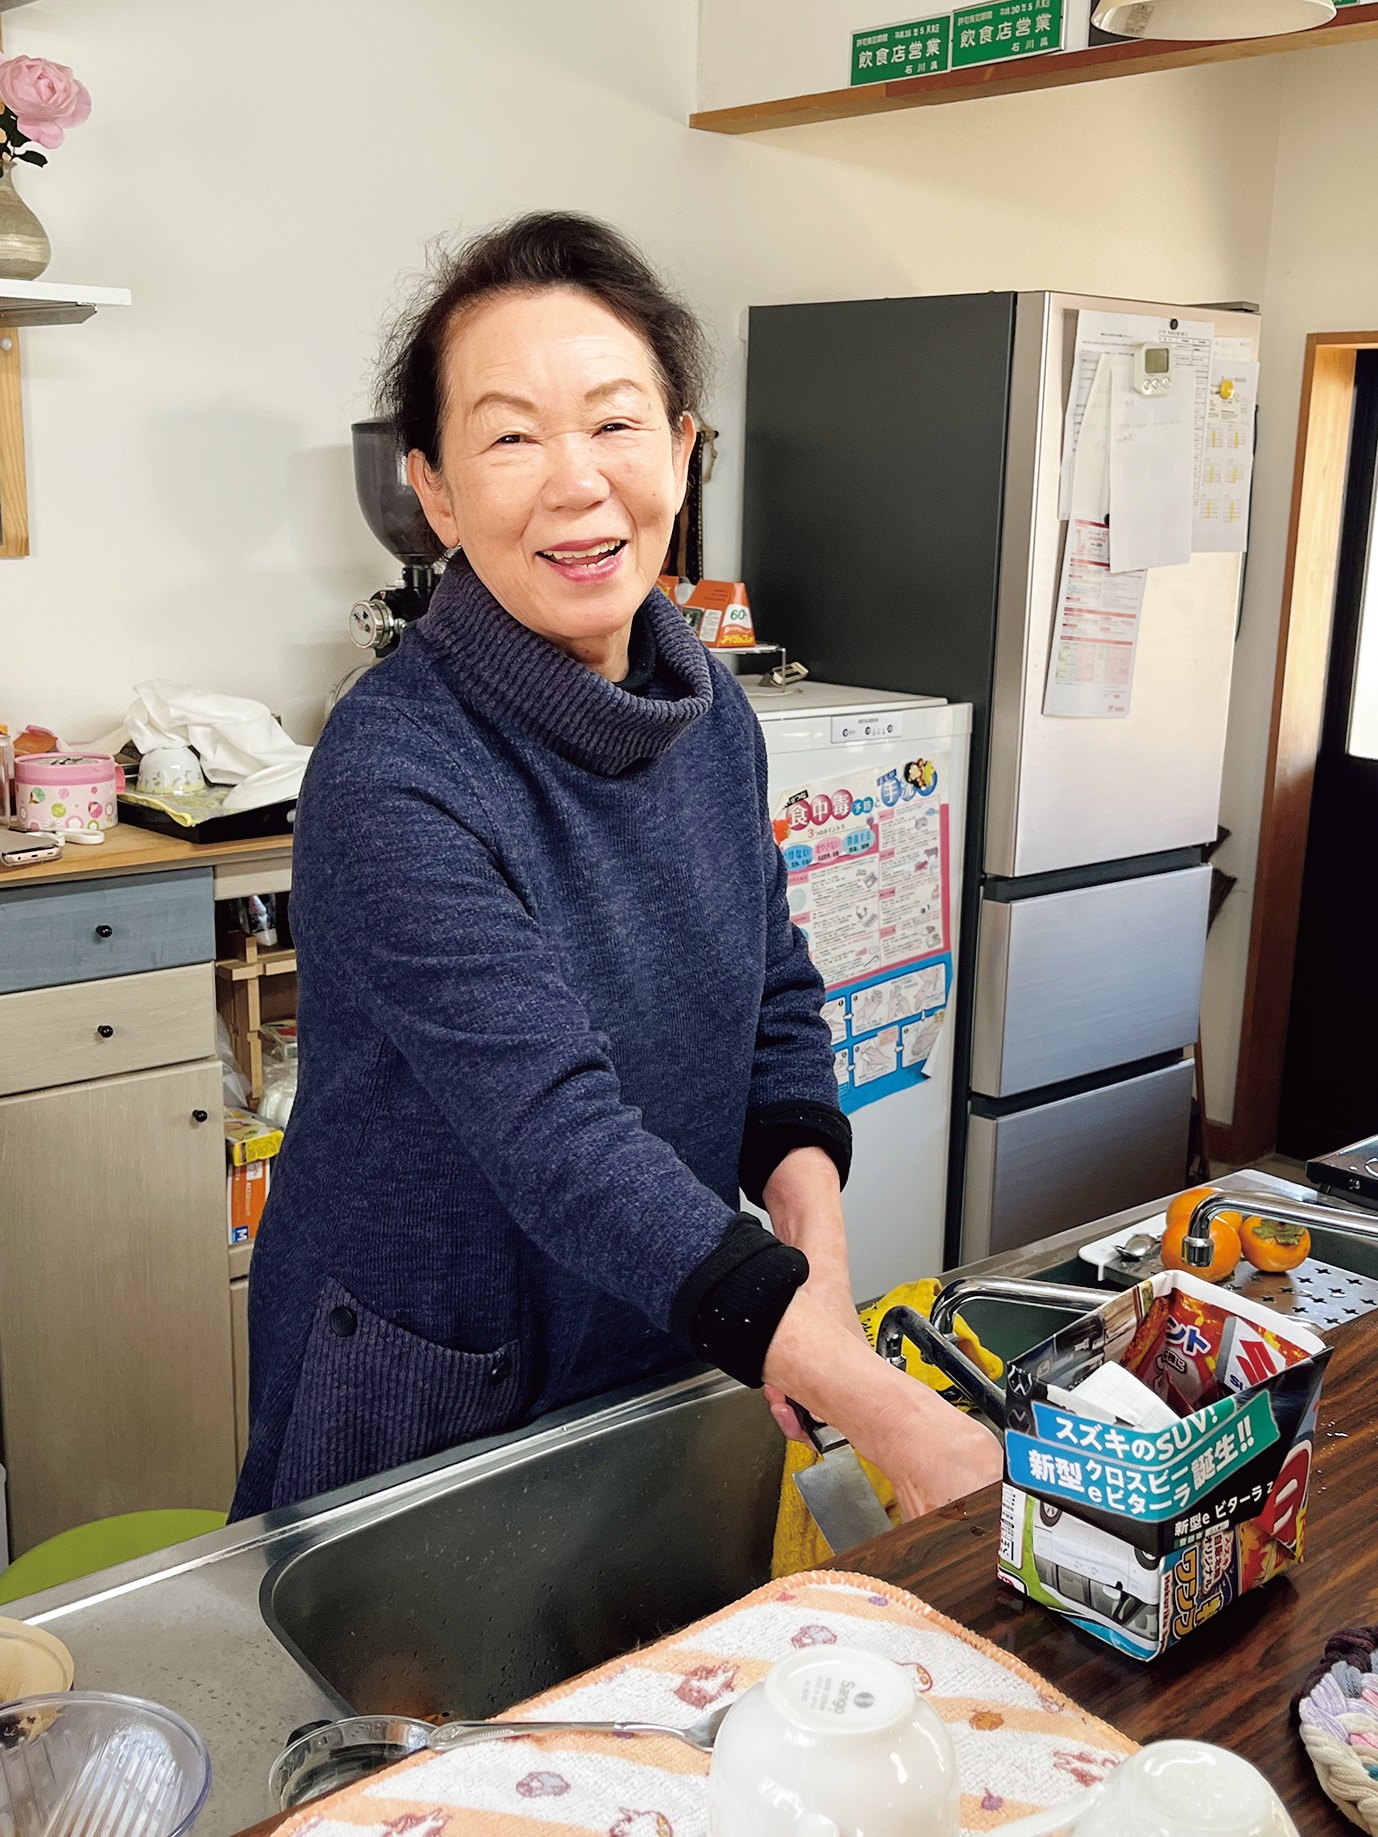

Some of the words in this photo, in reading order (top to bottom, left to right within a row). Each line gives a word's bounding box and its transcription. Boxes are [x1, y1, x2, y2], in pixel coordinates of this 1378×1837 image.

[960, 13, 1052, 48] 飲食店営業
[1011, 36, 1049, 52] 石川県
[858, 37, 941, 69] 飲食店営業
[905, 60, 938, 75] 石川県
[1055, 1406, 1219, 1461] スズキのSUV!
[1028, 1448, 1085, 1493] 新型
[1085, 1459, 1189, 1495] クロスビー
[1087, 1483, 1191, 1515] eビターラ
[1214, 1485, 1264, 1519] ビターラ
[1204, 1535, 1213, 1590] オリジナル
[832, 1680, 856, 1715] Sango
